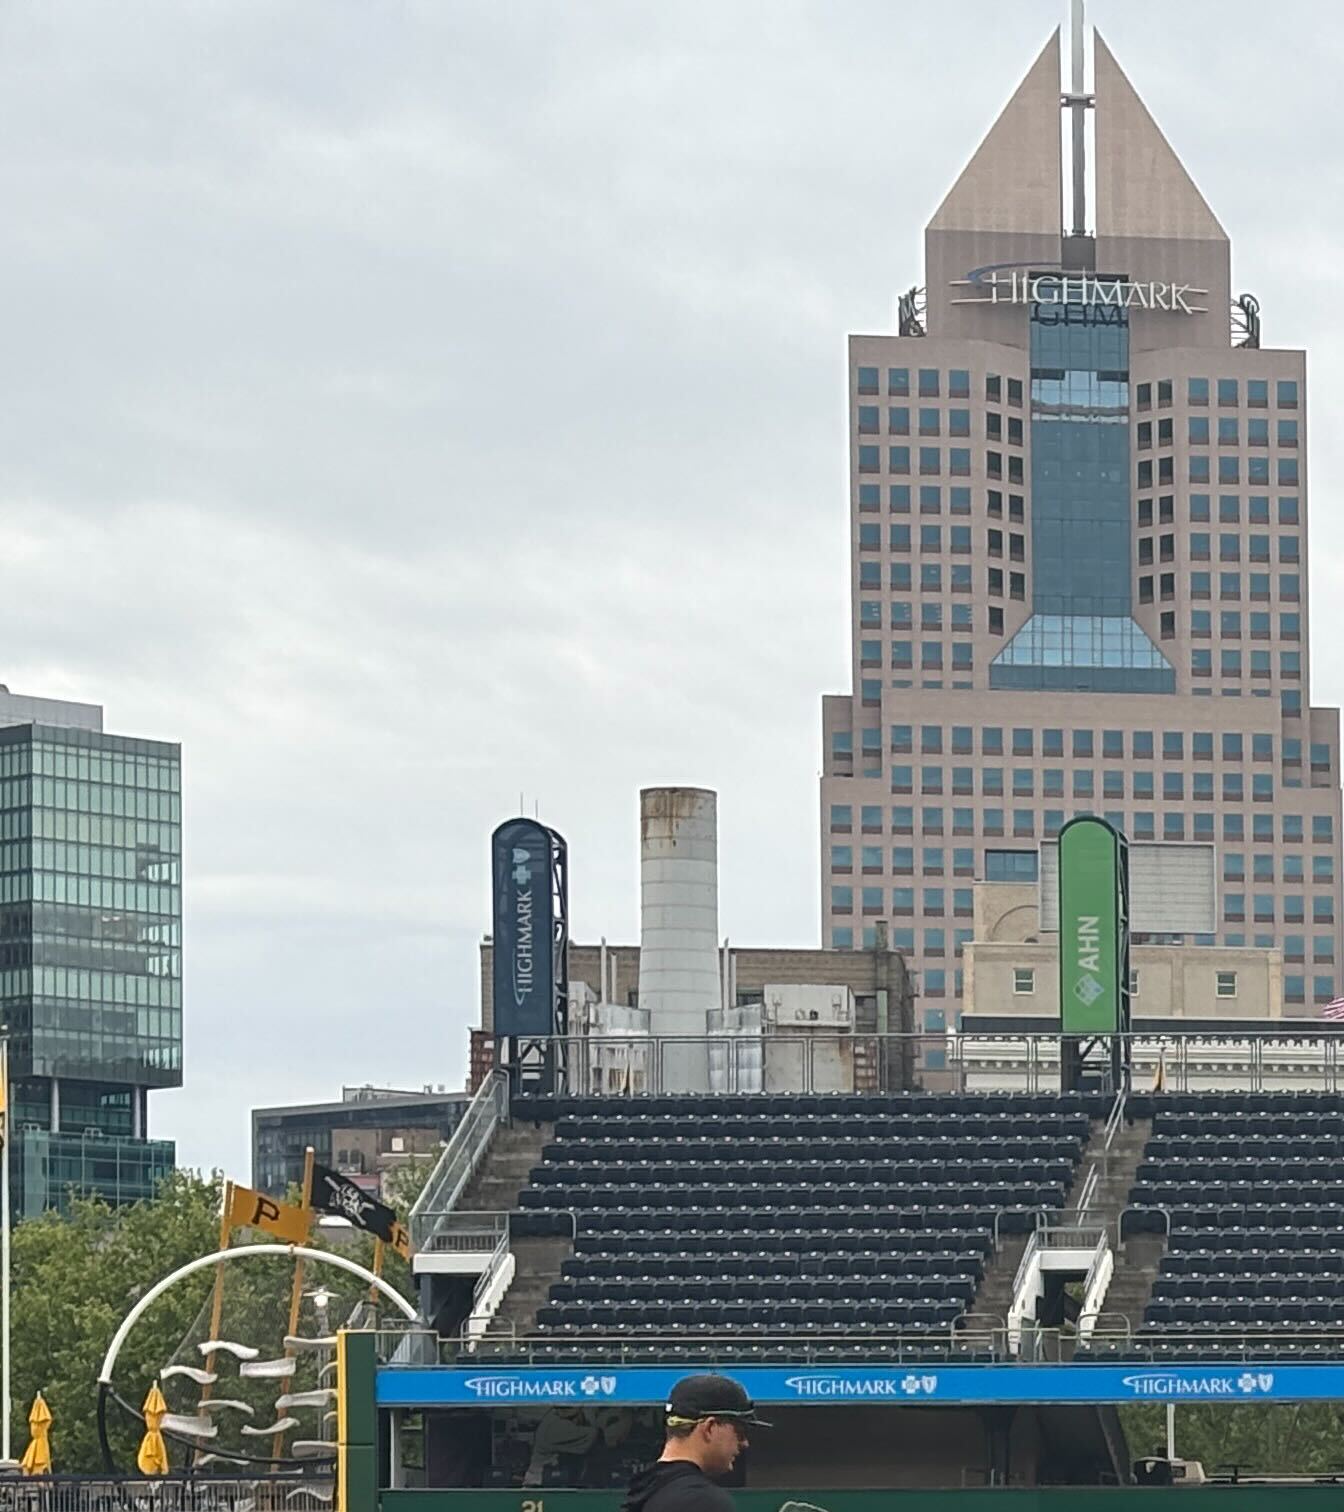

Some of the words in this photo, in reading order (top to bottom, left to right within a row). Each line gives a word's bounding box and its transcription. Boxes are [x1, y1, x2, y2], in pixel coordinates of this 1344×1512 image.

[985, 268, 1193, 314] HIGHMARK
[514, 889, 533, 998] HIGHMARK
[1078, 916, 1099, 972] AHN
[252, 1197, 280, 1225] P
[469, 1378, 576, 1397] HIGHMARK
[791, 1377, 896, 1395] HIGHMARK
[1127, 1376, 1233, 1394] HIGHMARK
